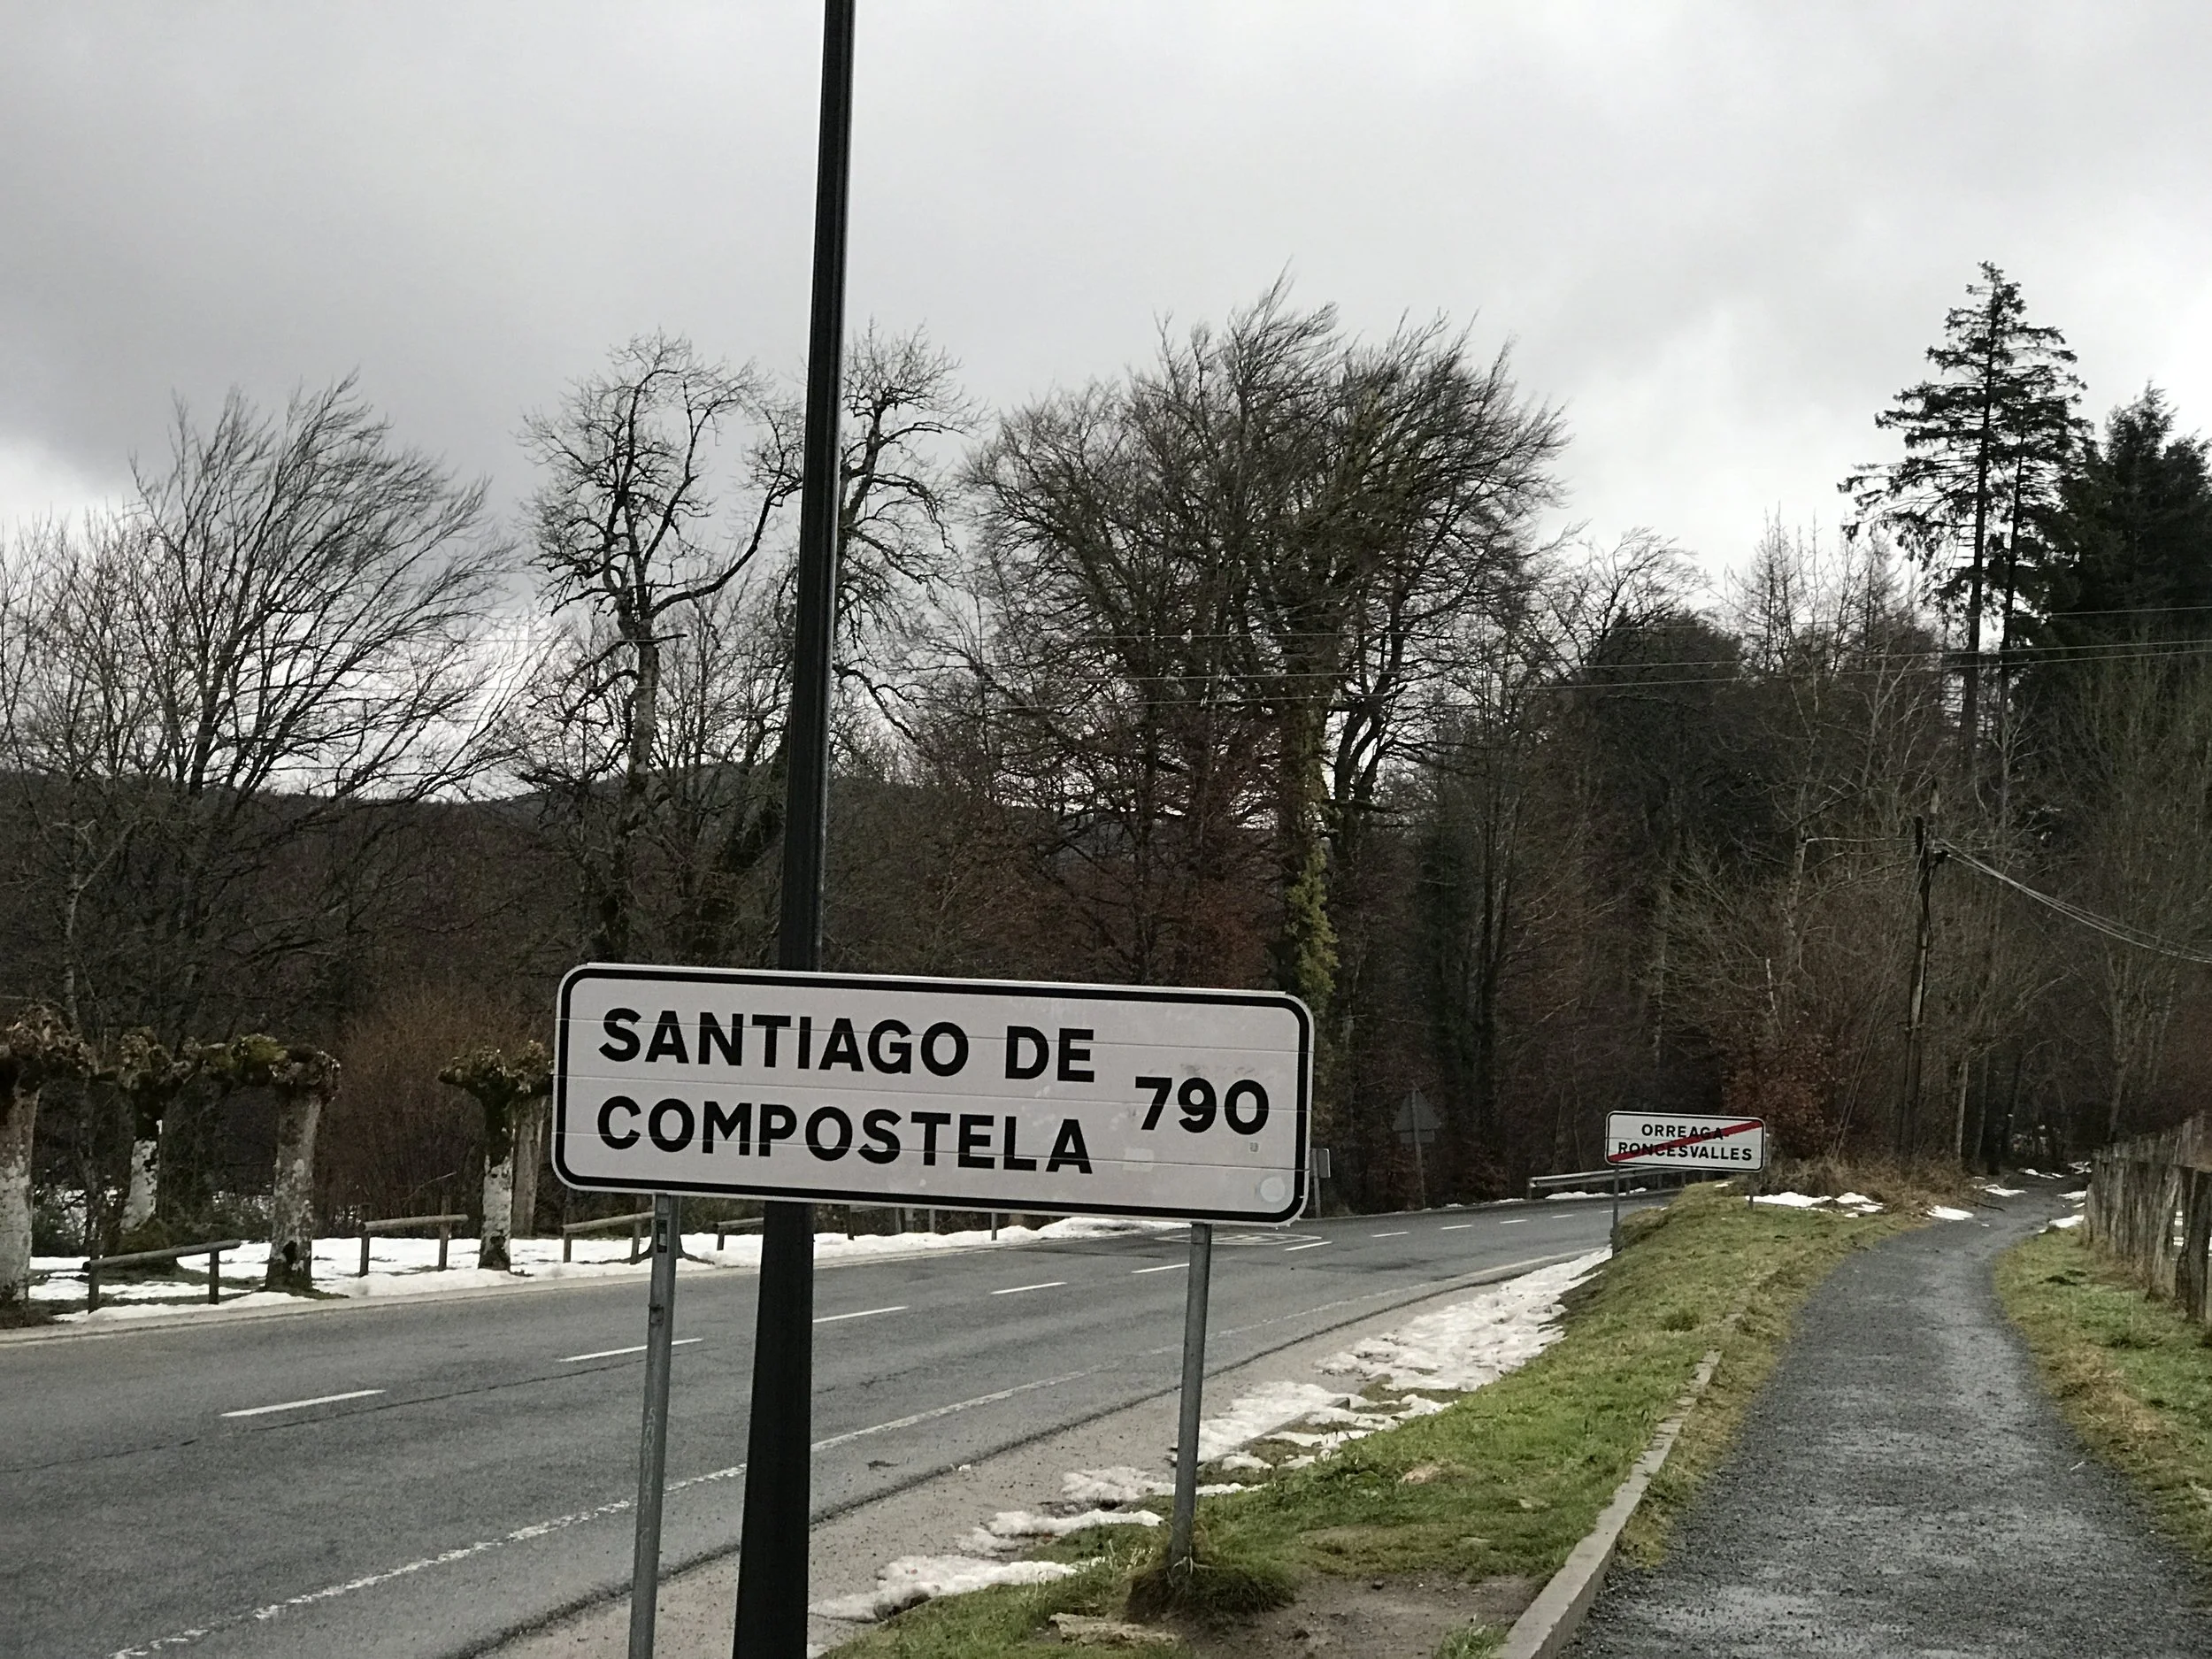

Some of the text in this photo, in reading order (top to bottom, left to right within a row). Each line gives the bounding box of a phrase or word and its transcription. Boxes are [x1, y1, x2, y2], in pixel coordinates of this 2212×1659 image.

[598, 1008, 1095, 1083] SANTIAGO DE
[597, 1095, 1094, 1175] COMPOSTELA
[1134, 1076, 1271, 1135] 790
[1617, 1142, 1752, 1161] RONCESVALLES
